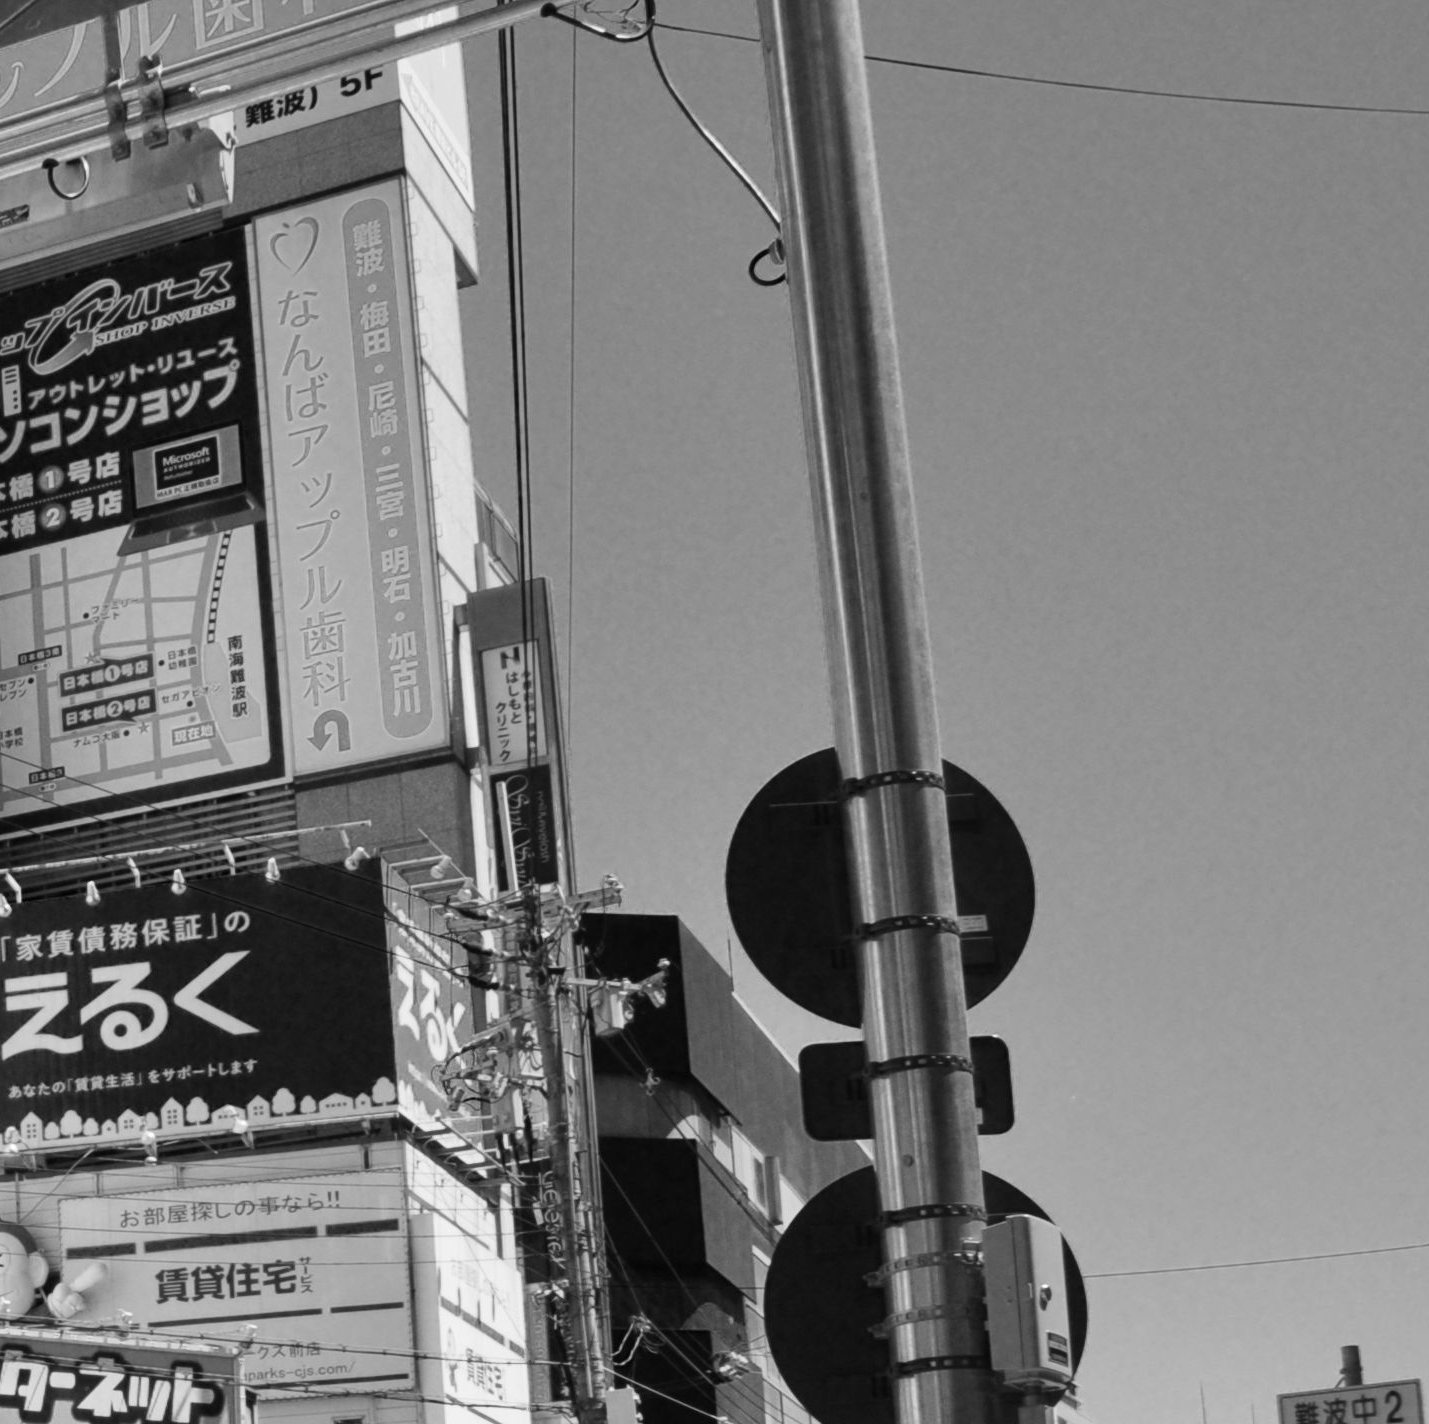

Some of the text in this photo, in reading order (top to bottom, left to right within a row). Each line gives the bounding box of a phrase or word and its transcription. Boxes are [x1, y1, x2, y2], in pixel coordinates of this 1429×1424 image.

[93, 296, 236, 348] SHOP INVERSE
[27, 337, 238, 410] アウトレット・リユース
[161, 446, 211, 467] Microsoft
[277, 288, 351, 705] なんばアップル歯科
[227, 634, 248, 719] 南海難波駅
[0, 910, 251, 963] 「家賃債務保証」の
[1, 949, 261, 1062] えるく
[155, 1259, 298, 1305] 賃貸住宅
[298, 1255, 314, 1294] サービス
